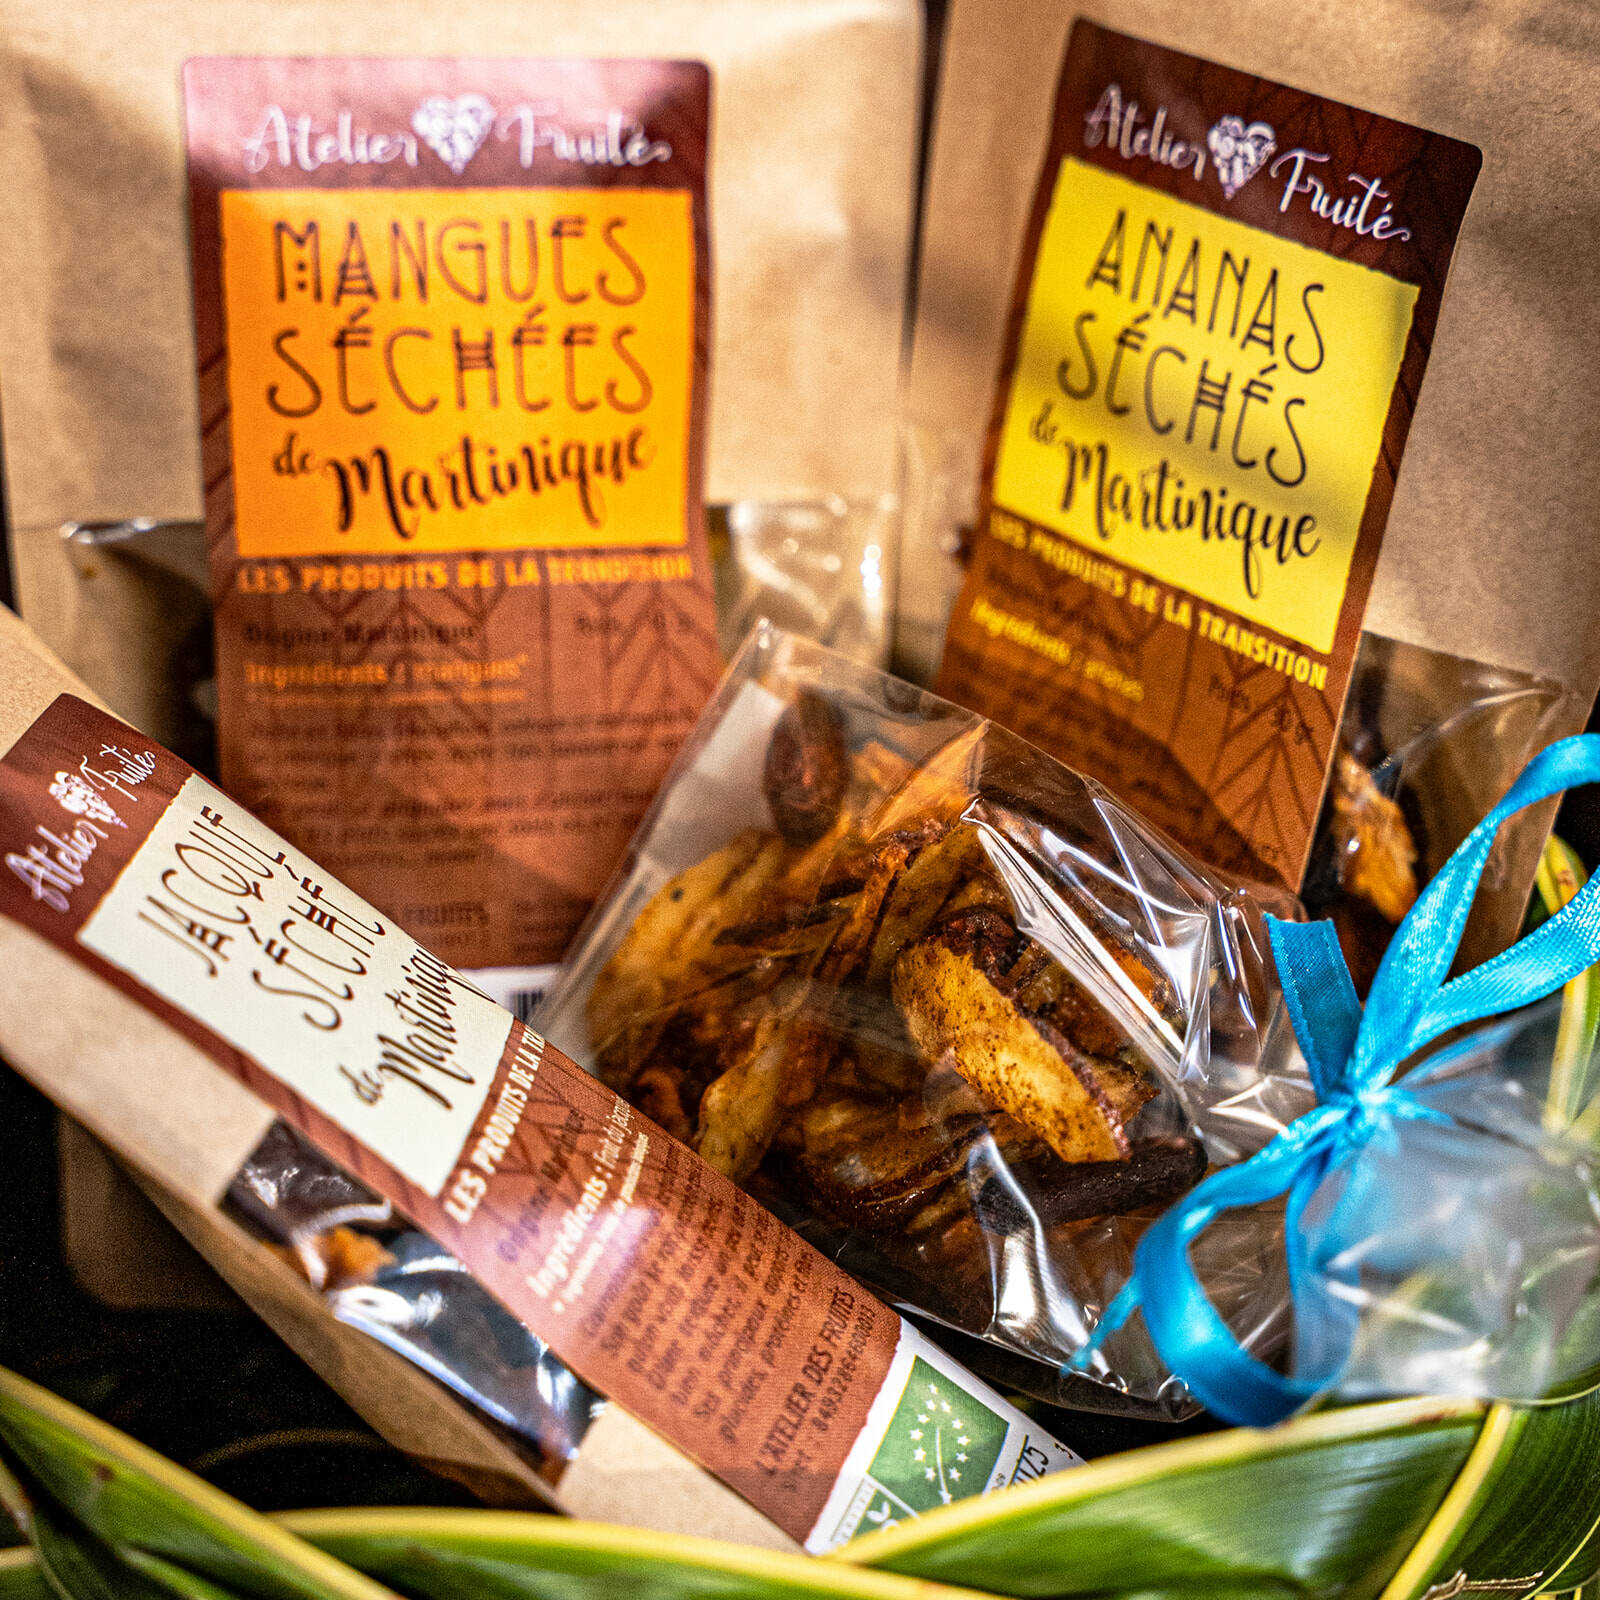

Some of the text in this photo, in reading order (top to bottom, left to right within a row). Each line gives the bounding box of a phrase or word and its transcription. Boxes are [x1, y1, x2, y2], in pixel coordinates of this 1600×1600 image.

[244, 104, 419, 173] Atelier
[1084, 83, 1412, 243] Atelier Fruité
[273, 214, 647, 307] MANGUES
[1086, 207, 1325, 376] ANANAS
[266, 305, 653, 418] SÉCHÉES
[1056, 310, 1307, 489] SÉCHÉS
[273, 426, 655, 541] de Martinique
[1028, 399, 1321, 602] de Martinique
[238, 566, 290, 595] LES
[301, 561, 449, 593] PRODUITS
[457, 559, 496, 589] DE
[505, 558, 540, 588] LA
[989, 511, 1027, 550] LES
[1029, 530, 1128, 599] PRODUITS
[1129, 579, 1160, 615] DE
[1163, 593, 1192, 630] LA
[1197, 607, 1329, 691] TRANSITION
[3, 741, 157, 913] Atelier Fruité
[137, 805, 287, 978] JACQUE
[249, 862, 386, 1032] SÉCHÉ
[336, 1063, 383, 1106] de
[508, 1063, 536, 1091] DE
[515, 1047, 541, 1071] LA
[470, 1083, 529, 1177] PRODUITS
[443, 1168, 487, 1225] LES
[526, 1175, 608, 1298] Ingrédients
[753, 1379, 816, 1481] L'ATELIER
[800, 1341, 834, 1388] DES
